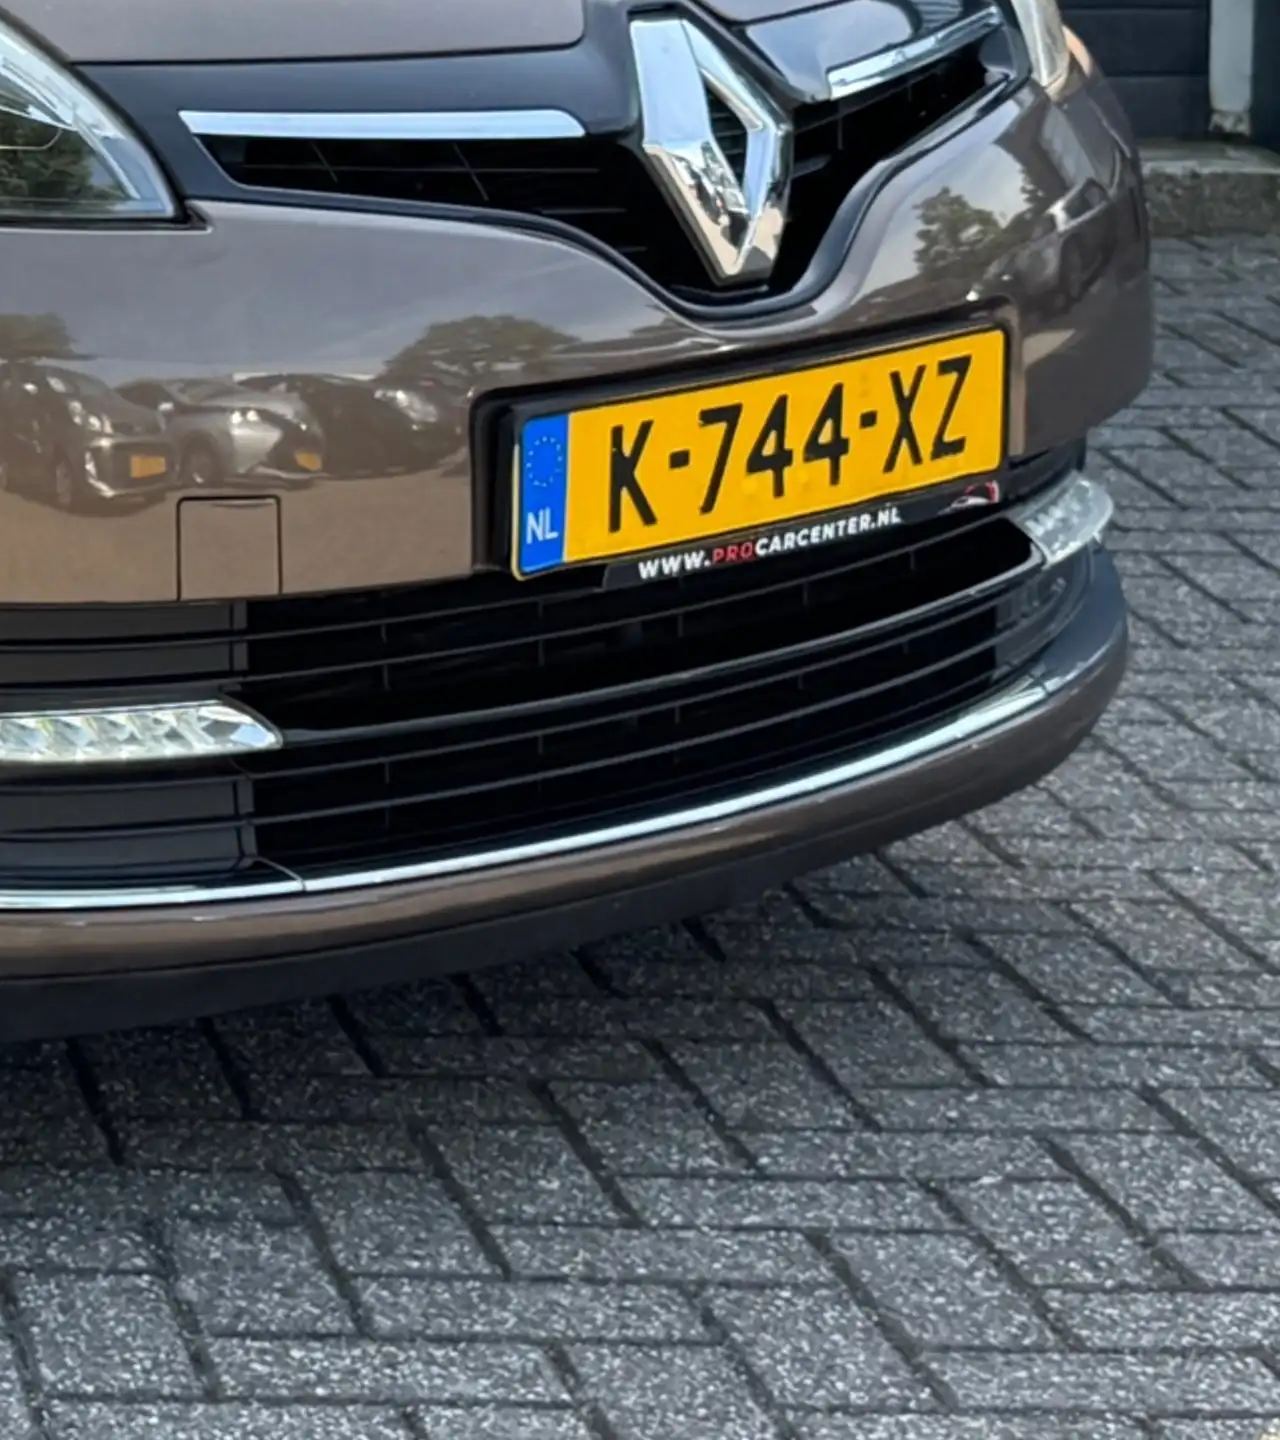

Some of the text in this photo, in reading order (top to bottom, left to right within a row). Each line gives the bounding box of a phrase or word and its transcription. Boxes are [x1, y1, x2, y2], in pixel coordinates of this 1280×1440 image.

[608, 354, 973, 534] K-744-XZ
[526, 506, 560, 545] NL
[636, 505, 902, 581] WWW.PROCARCENTER.NL
